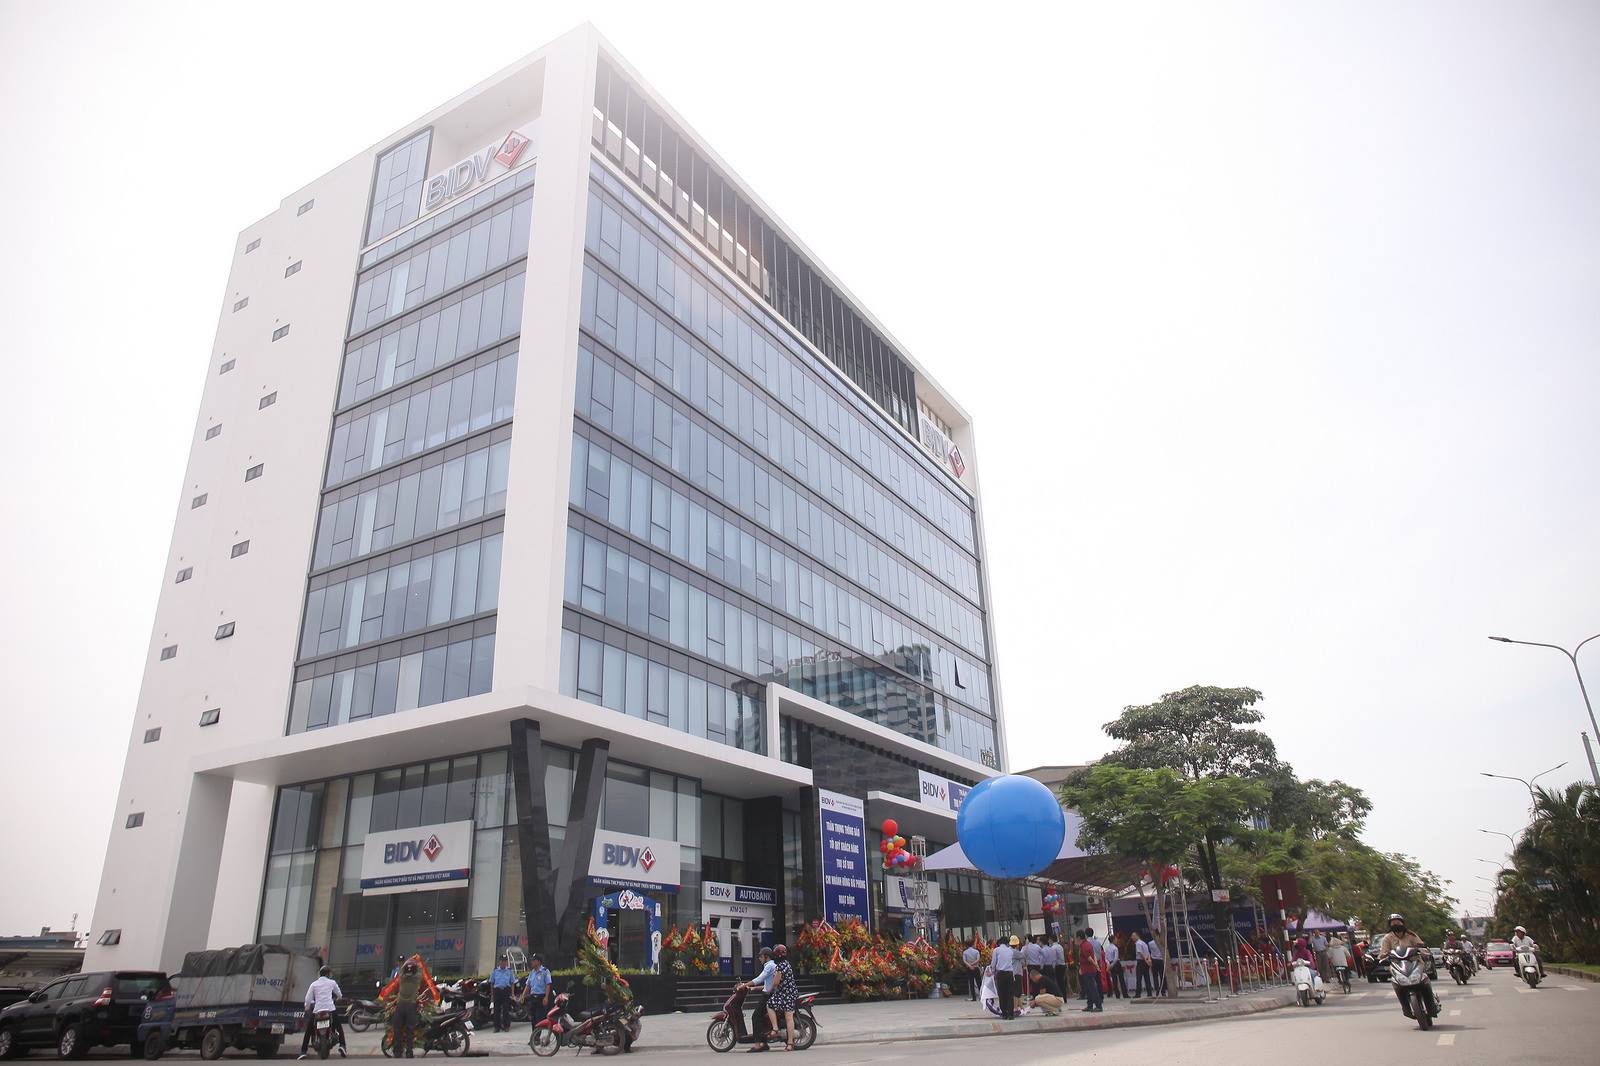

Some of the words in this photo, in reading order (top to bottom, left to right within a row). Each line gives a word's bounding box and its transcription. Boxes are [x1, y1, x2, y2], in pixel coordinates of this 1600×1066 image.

[426, 144, 494, 210] BIDV
[922, 781, 939, 798] BIDV
[384, 840, 425, 864] BIDV
[603, 843, 641, 868] BIDV
[710, 887, 724, 896] BIDV
[740, 890, 772, 900] AUTOBANK
[434, 938, 456, 950] BIDV
[497, 936, 519, 947] BIDV
